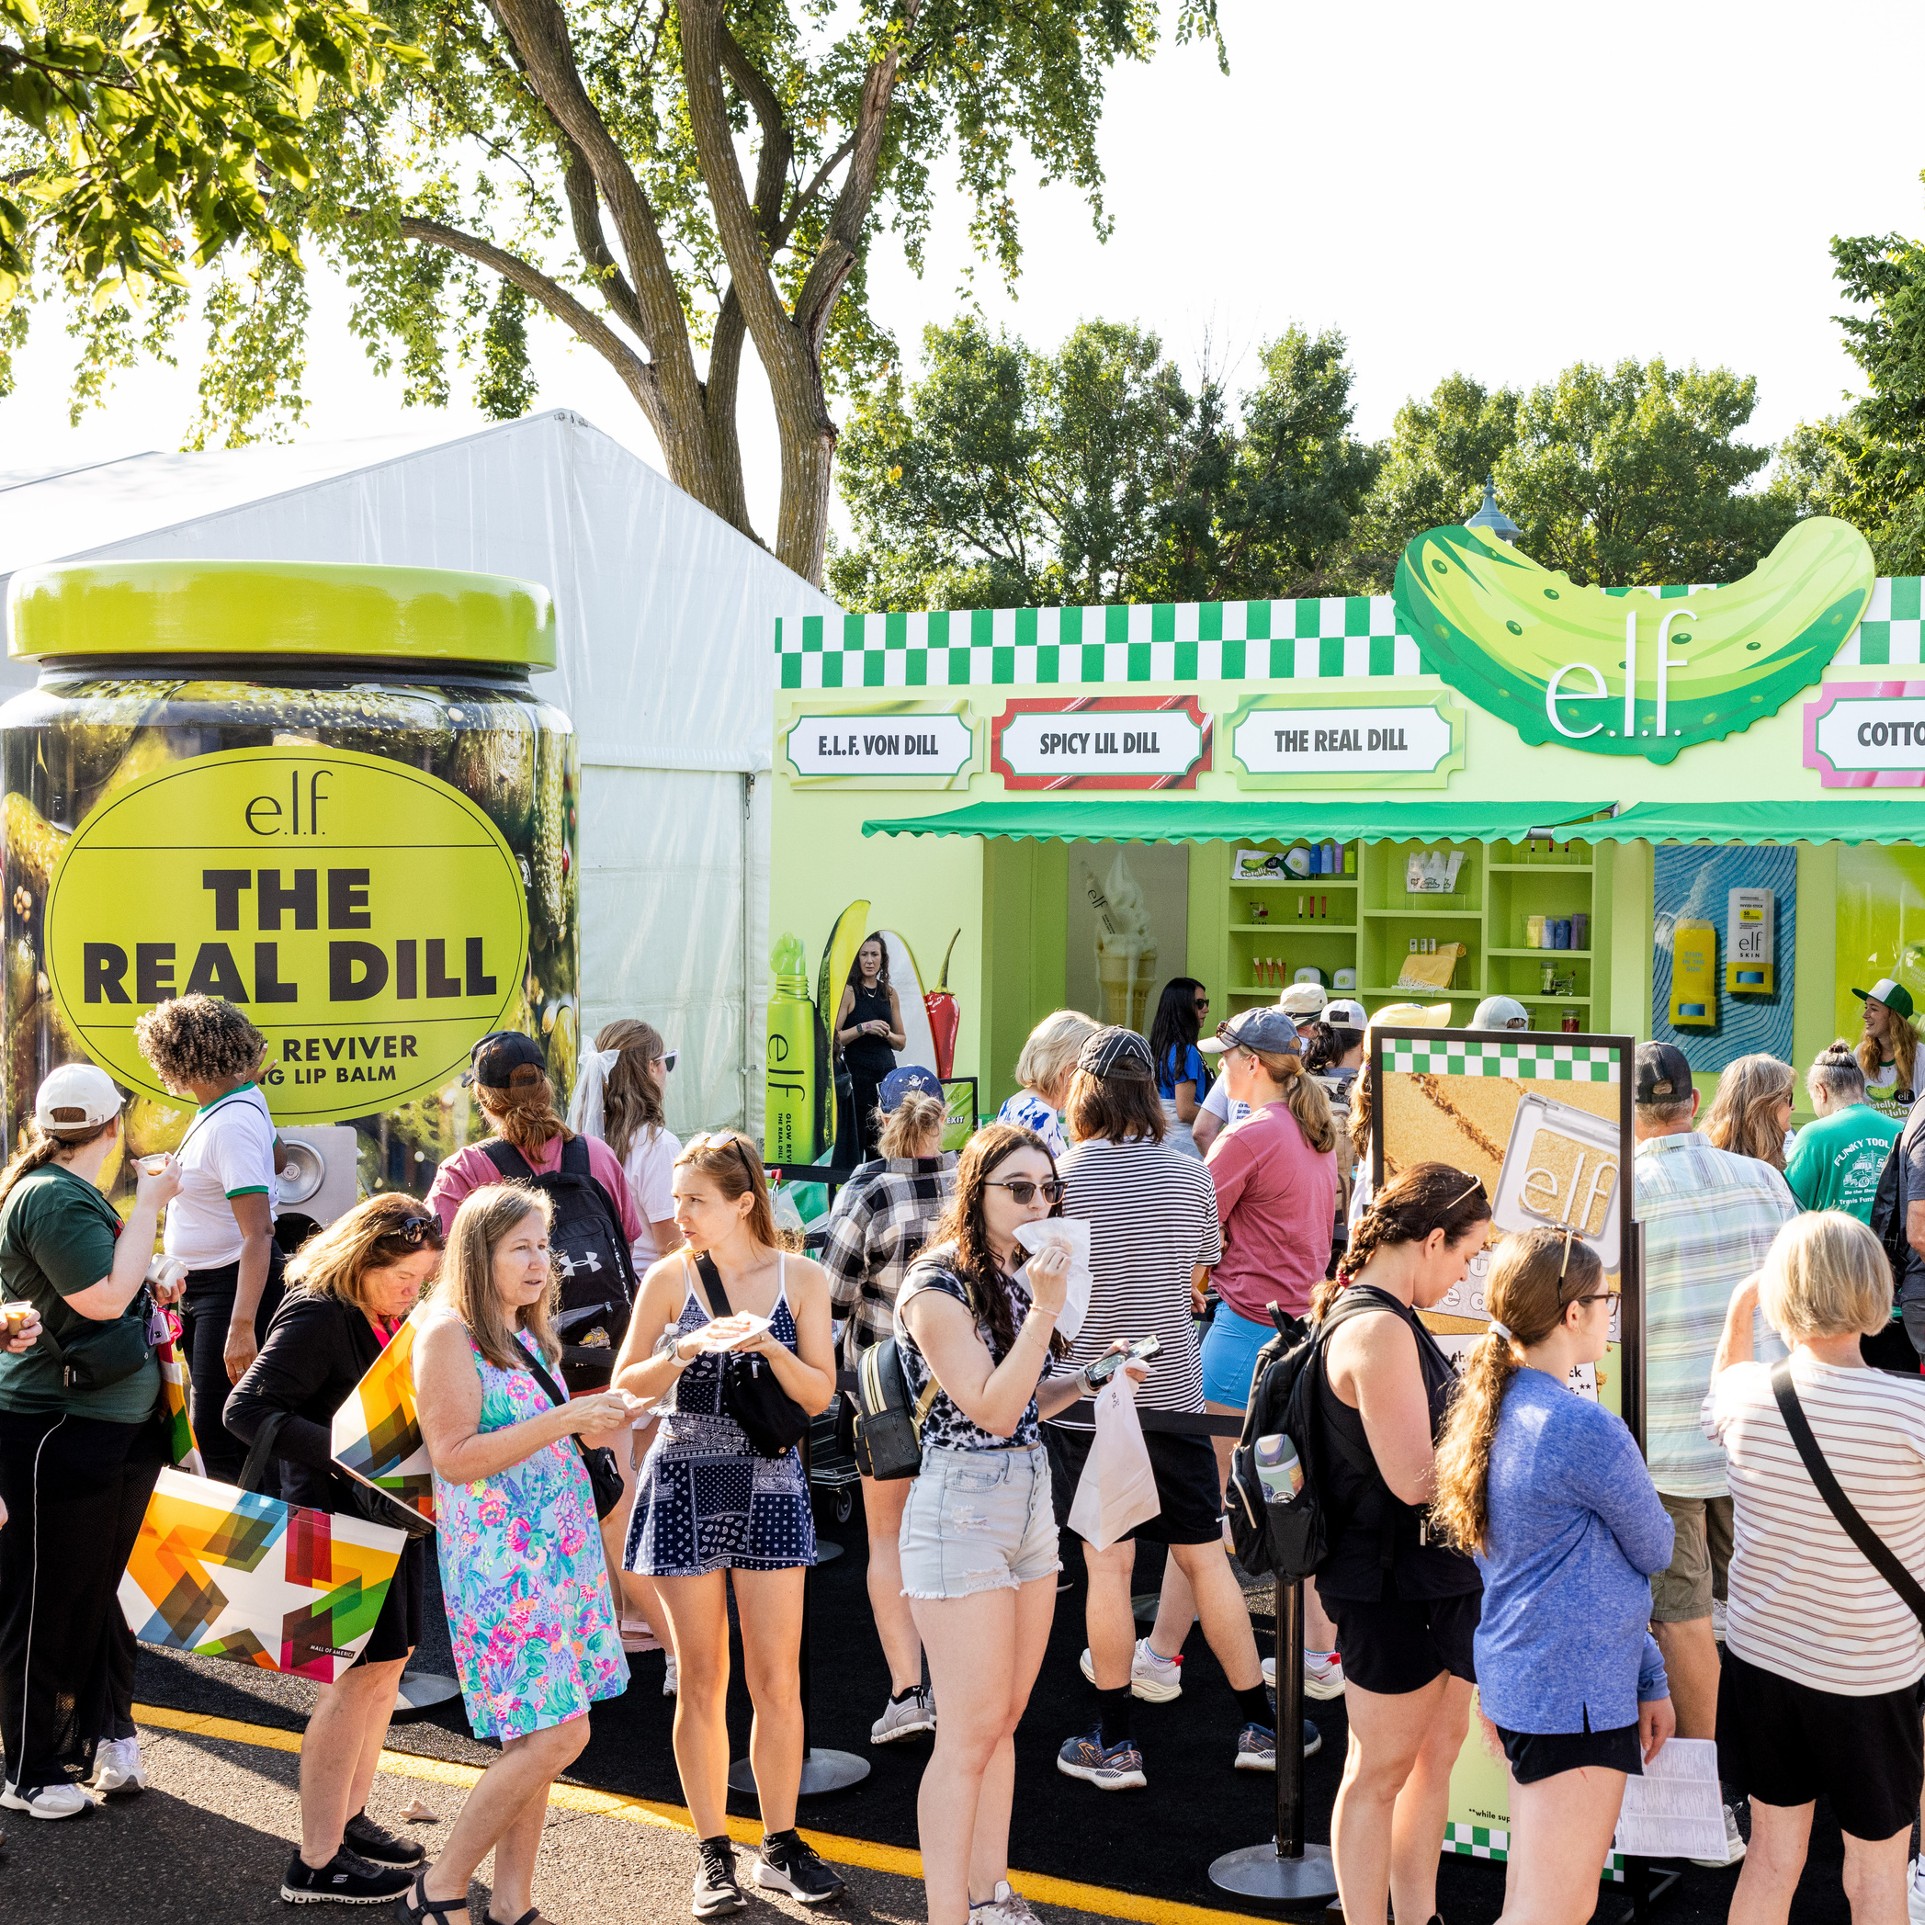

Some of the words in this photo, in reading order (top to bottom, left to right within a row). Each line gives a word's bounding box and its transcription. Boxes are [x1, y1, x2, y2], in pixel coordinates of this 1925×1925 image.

[819, 735, 860, 755] E.L.F.
[863, 735, 900, 755] VON
[904, 735, 939, 755] DILL
[1040, 733, 1090, 754] SPICY
[1095, 733, 1118, 753] LIL
[1123, 732, 1160, 753] DILL
[1274, 730, 1309, 752] THE
[1314, 729, 1362, 751] REAL
[1368, 728, 1408, 751] DILL
[1857, 721, 1925, 747] COTTO
[245, 770, 333, 836] e.l.f.
[202, 868, 371, 931] THE
[83, 942, 298, 1004] REAL
[328, 937, 497, 1002] DILL
[283, 1035, 418, 1062] REVIVER
[295, 1068, 327, 1084] LIP
[336, 1065, 397, 1083] BALM
[946, 1116, 964, 1124] EXIT
[1833, 1139, 1864, 1168] FUNKY
[1865, 1137, 1891, 1149] TOOL
